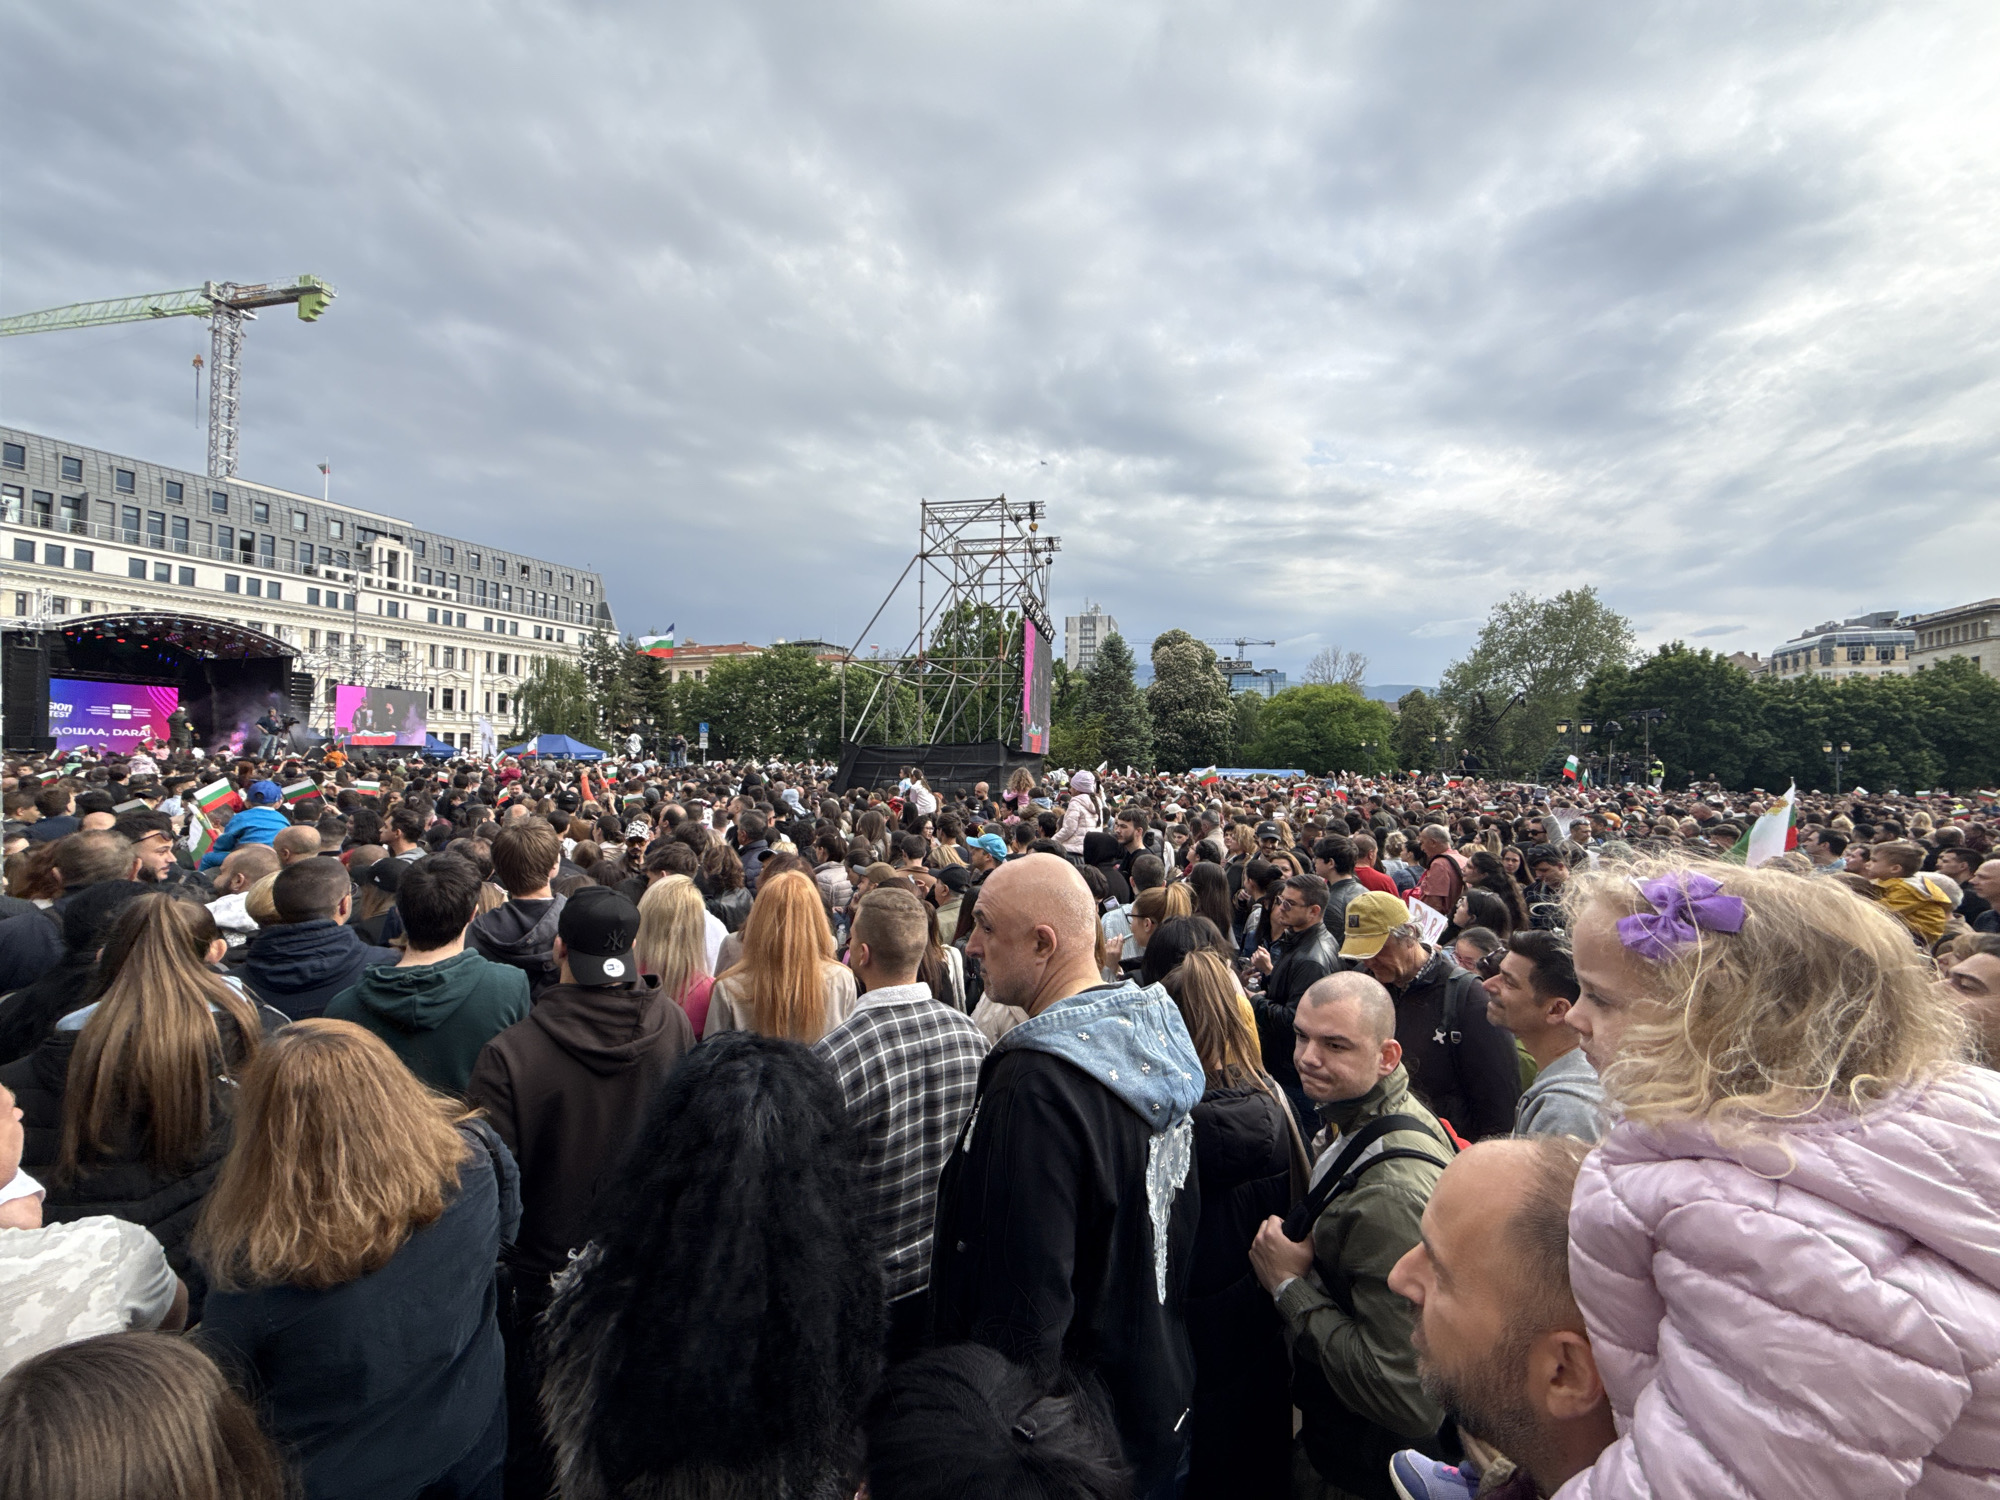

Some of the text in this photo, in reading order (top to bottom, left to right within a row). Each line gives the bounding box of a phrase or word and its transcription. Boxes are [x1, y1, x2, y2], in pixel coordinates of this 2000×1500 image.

[1231, 661, 1251, 669] SOFIA
[50, 726, 151, 737] ДОШЛА, DARA!
